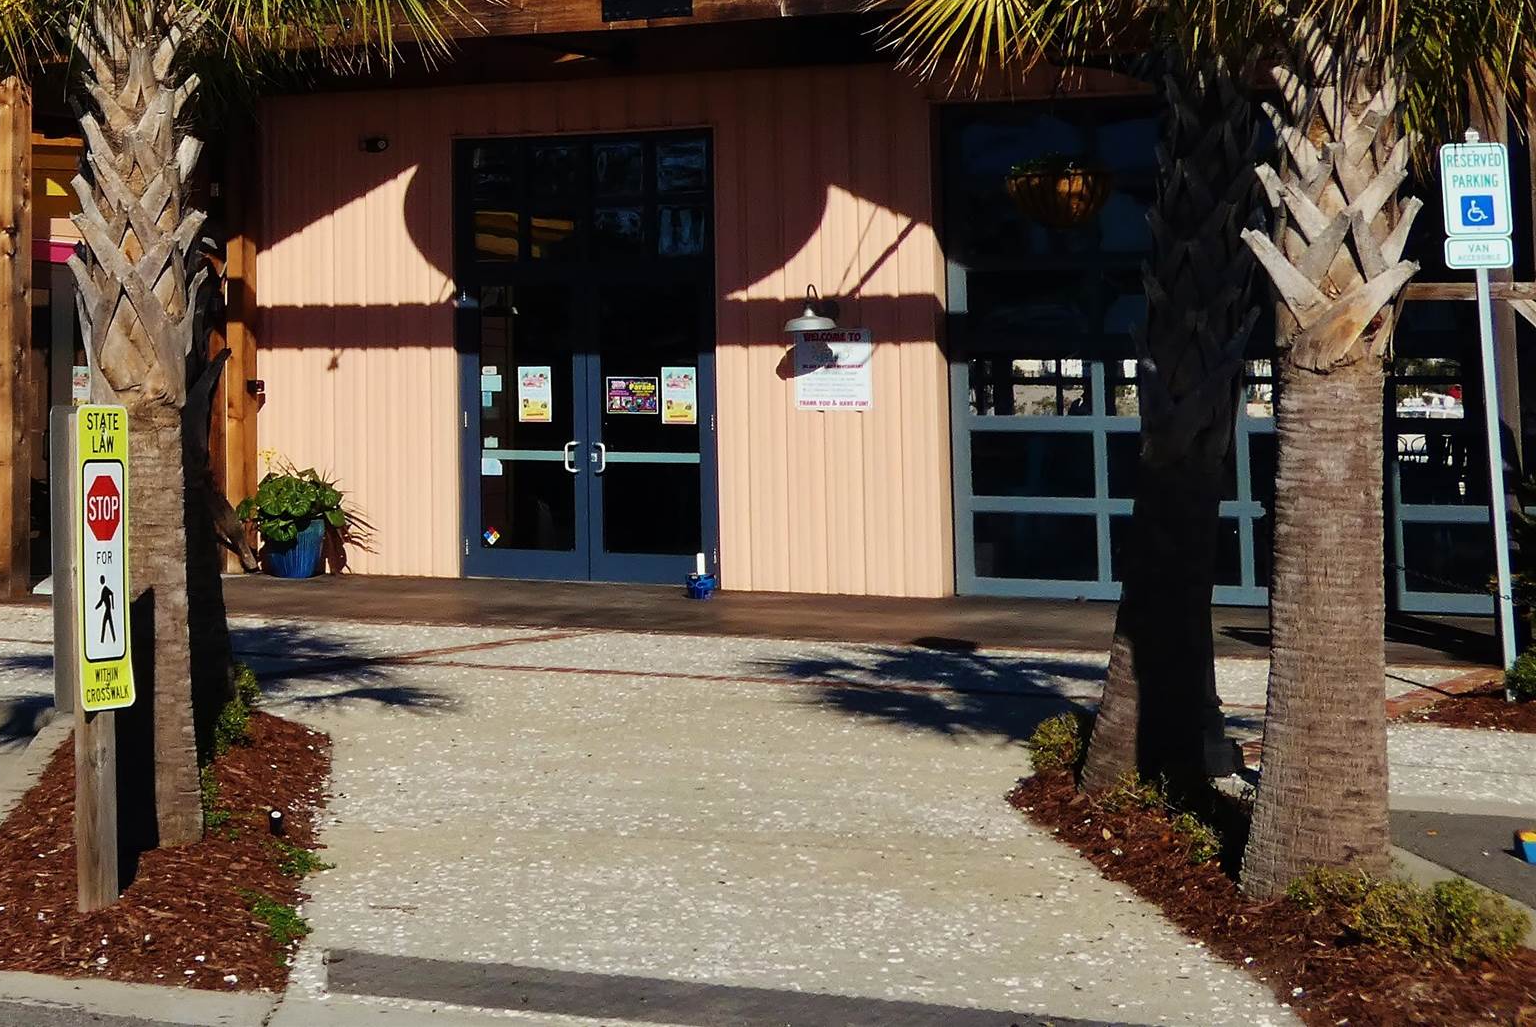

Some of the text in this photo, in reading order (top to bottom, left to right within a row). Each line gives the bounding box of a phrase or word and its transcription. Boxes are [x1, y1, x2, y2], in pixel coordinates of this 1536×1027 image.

[1446, 152, 1502, 168] RESERVED
[1452, 173, 1499, 189] PARKING
[1467, 244, 1490, 253] VAN
[803, 332, 861, 342] WELCOME TO
[86, 412, 120, 431] STATE
[91, 435, 115, 454] LAW
[88, 494, 120, 522] STOP
[96, 550, 113, 565] FOR
[94, 667, 119, 683] WITHIN
[85, 684, 130, 704] CROSSWALK
